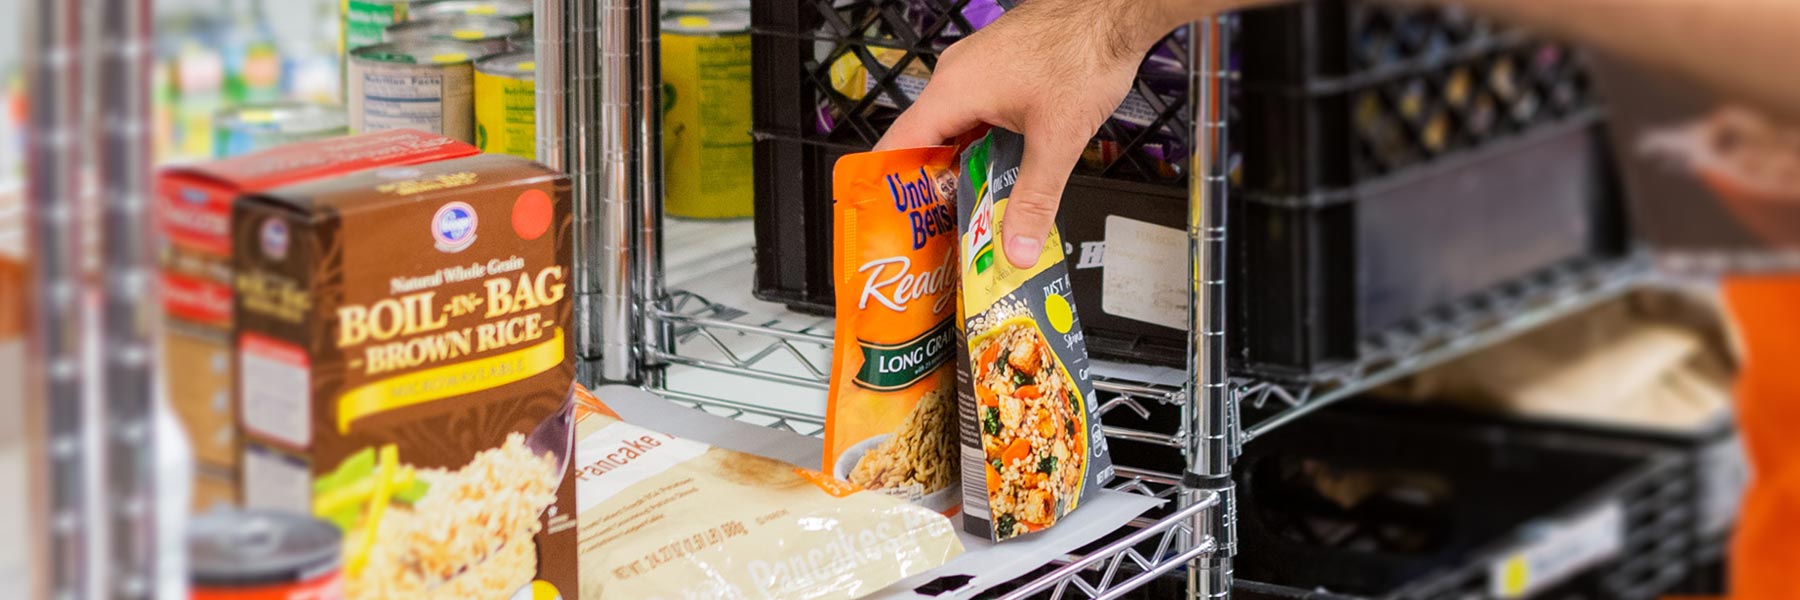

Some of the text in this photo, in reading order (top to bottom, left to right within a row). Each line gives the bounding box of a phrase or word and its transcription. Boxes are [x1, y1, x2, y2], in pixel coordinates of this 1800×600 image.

[389, 255, 525, 294] Natural Whole Grain
[857, 246, 957, 314] Ready
[336, 291, 448, 348] BOIL
[483, 266, 566, 319] BAG
[879, 346, 923, 374] LONG
[576, 435, 662, 482] Pancake
